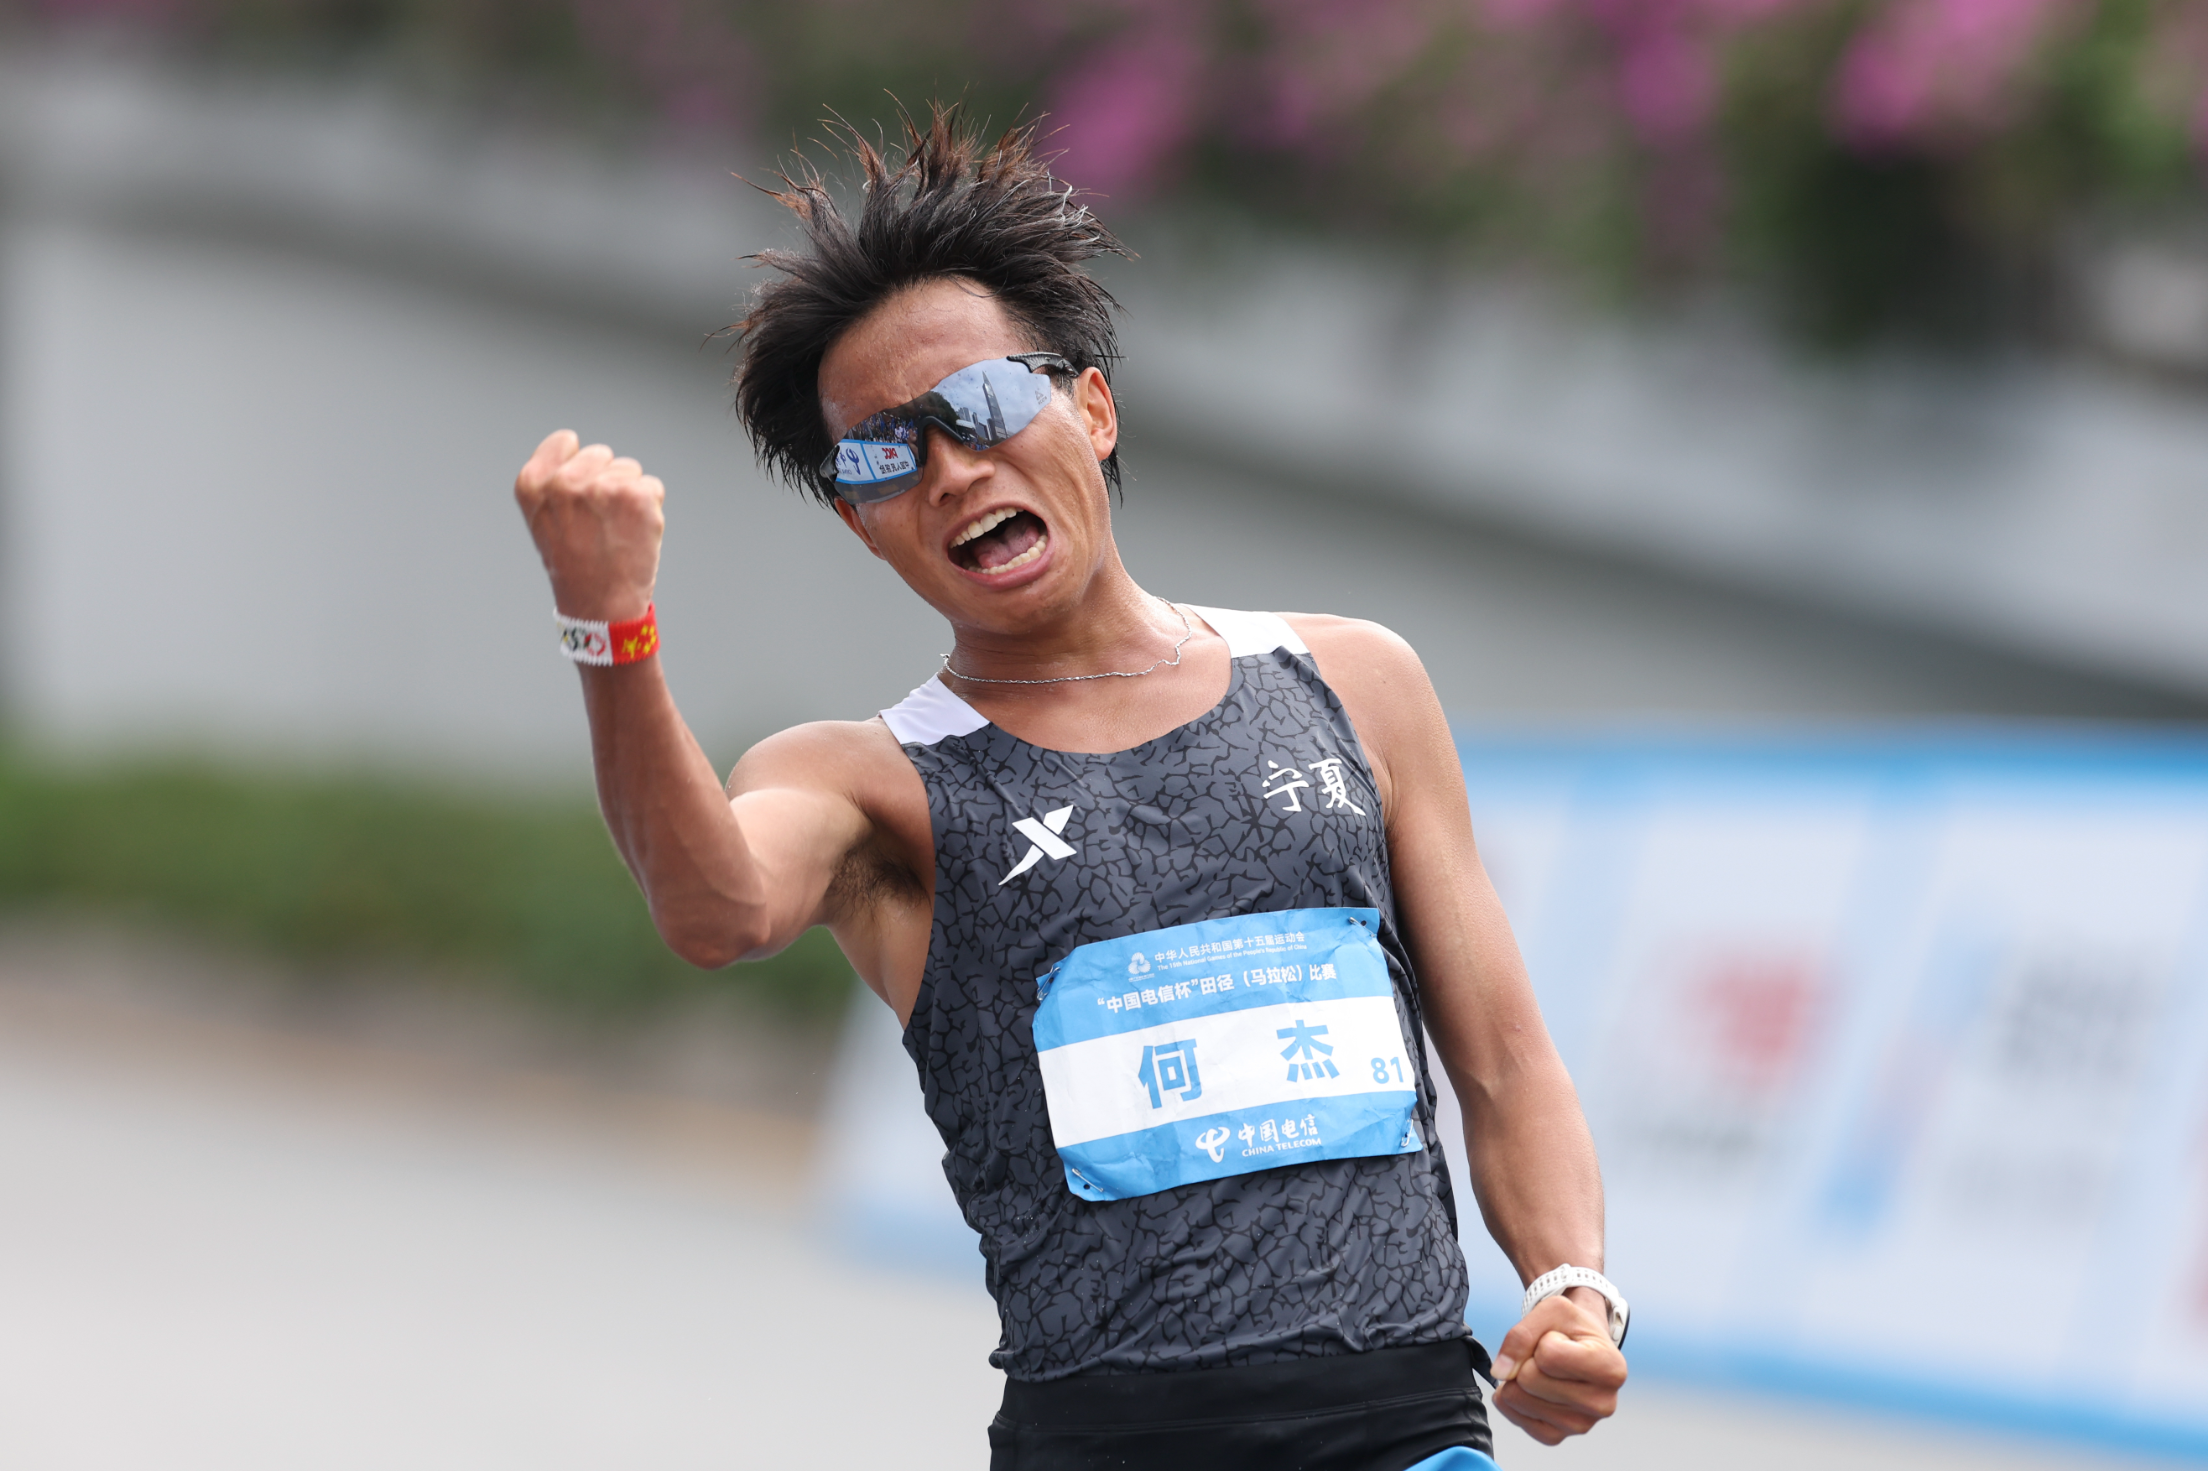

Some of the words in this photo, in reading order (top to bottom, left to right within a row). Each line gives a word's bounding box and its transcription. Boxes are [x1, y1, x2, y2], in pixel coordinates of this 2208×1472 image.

[1261, 758, 1366, 816] 宁夏
[1154, 931, 1305, 964] 中华人民共和国第十五届运动会
[1169, 961, 1183, 969] 15th
[1182, 956, 1207, 966] National
[1206, 954, 1227, 962] Games
[1242, 947, 1266, 957] People's
[1265, 946, 1287, 954] Republic
[1137, 1038, 1203, 1109] 何
[1275, 1019, 1340, 1083] 杰
[1370, 1056, 1404, 1084] 81
[1237, 1113, 1319, 1149] 中国电信
[1241, 1144, 1275, 1157] CHINA
[1275, 1137, 1322, 1152] TELECOM
